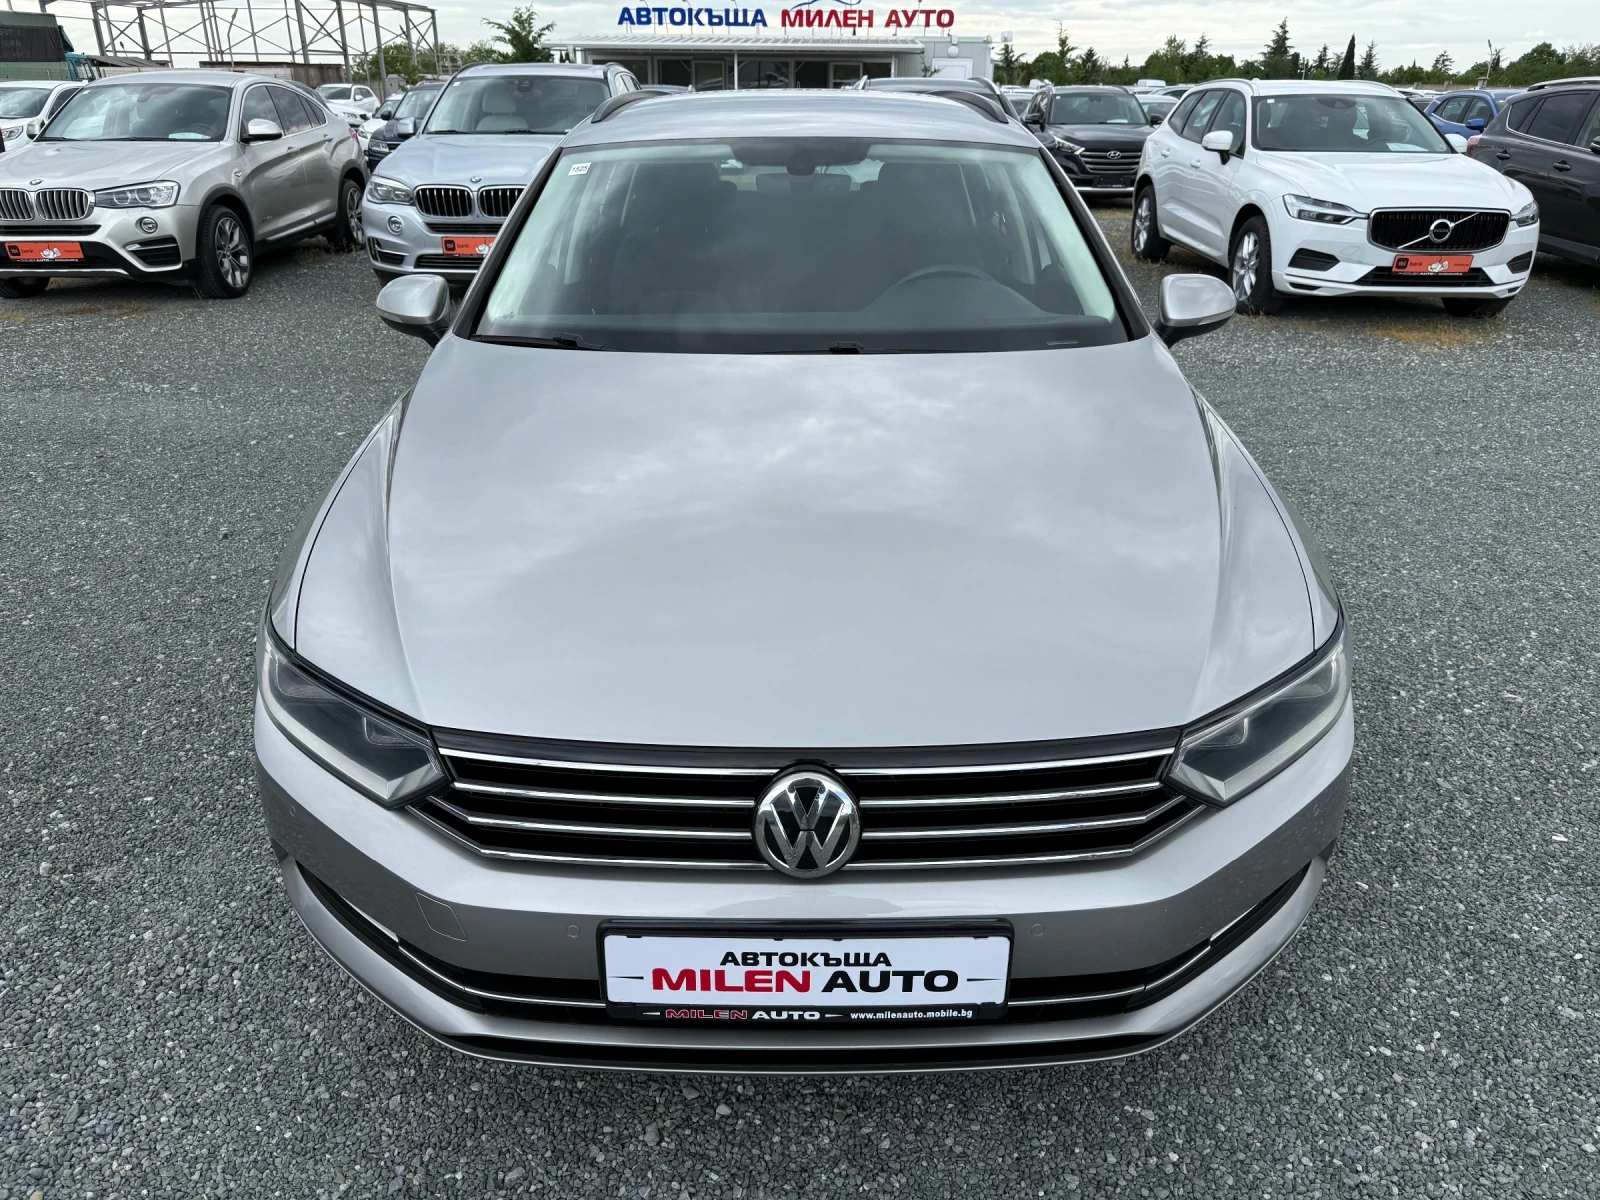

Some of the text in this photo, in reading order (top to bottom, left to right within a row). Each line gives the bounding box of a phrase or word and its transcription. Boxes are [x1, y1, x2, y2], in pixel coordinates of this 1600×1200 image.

[781, 9, 874, 28] МИЛЕН
[884, 9, 955, 28] АУТО
[651, 968, 959, 993] MILEN AUTO
[665, 1009, 973, 1020] MILEN AUTO www.milenauto.mobile.bg
